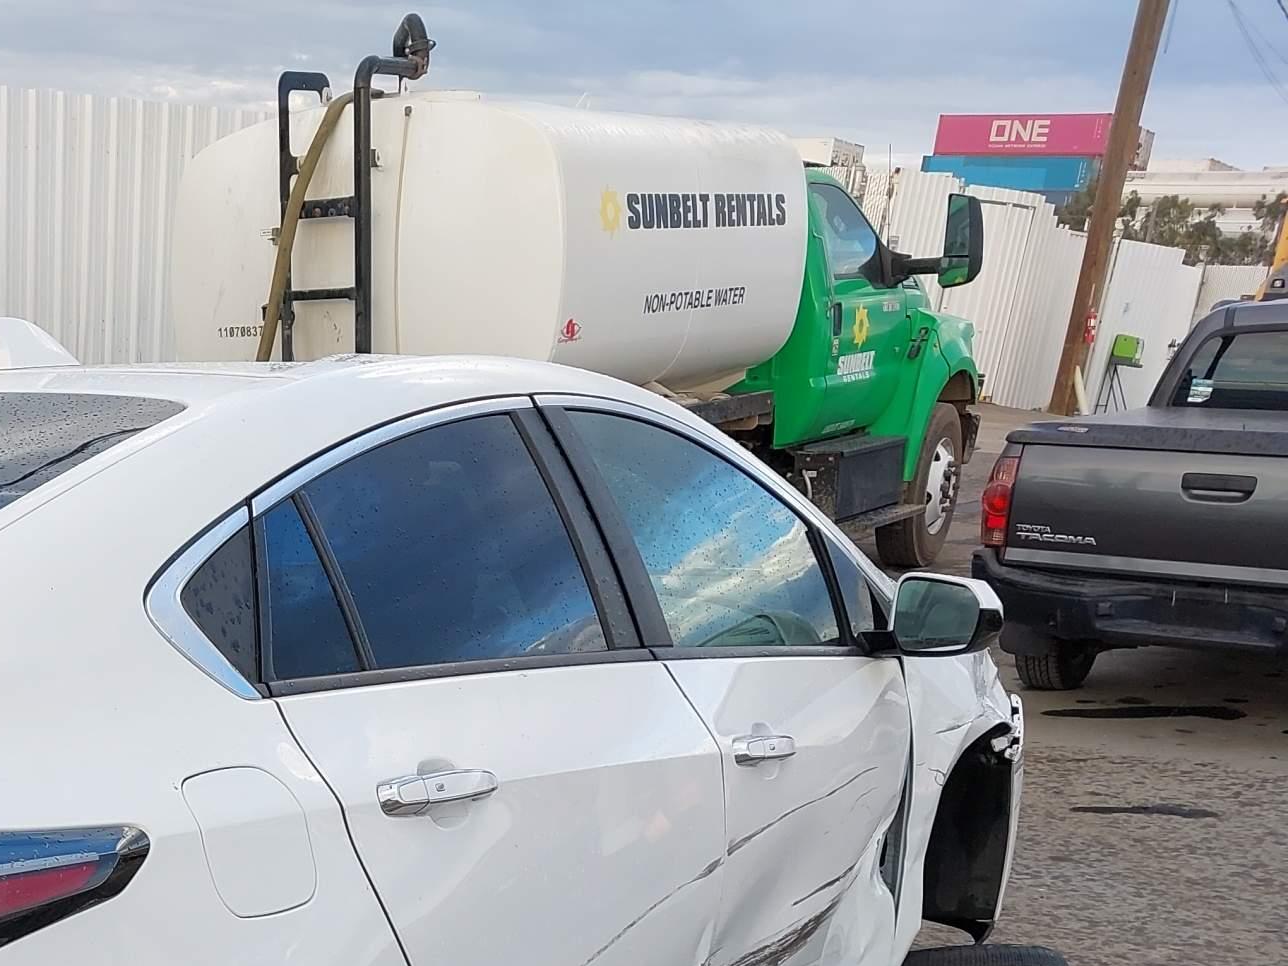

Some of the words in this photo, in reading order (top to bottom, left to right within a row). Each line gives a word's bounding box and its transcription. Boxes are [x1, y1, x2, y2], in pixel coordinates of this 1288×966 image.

[989, 119, 1051, 142] ONE
[626, 193, 710, 230] SUNBELT
[714, 193, 787, 228] RENTALS
[643, 289, 714, 314] NON-POTABLE
[714, 286, 746, 307] WATER
[843, 371, 870, 382] RENTALS
[1015, 523, 1051, 533] TOYOTA
[1015, 532, 1096, 546] TACOMA
